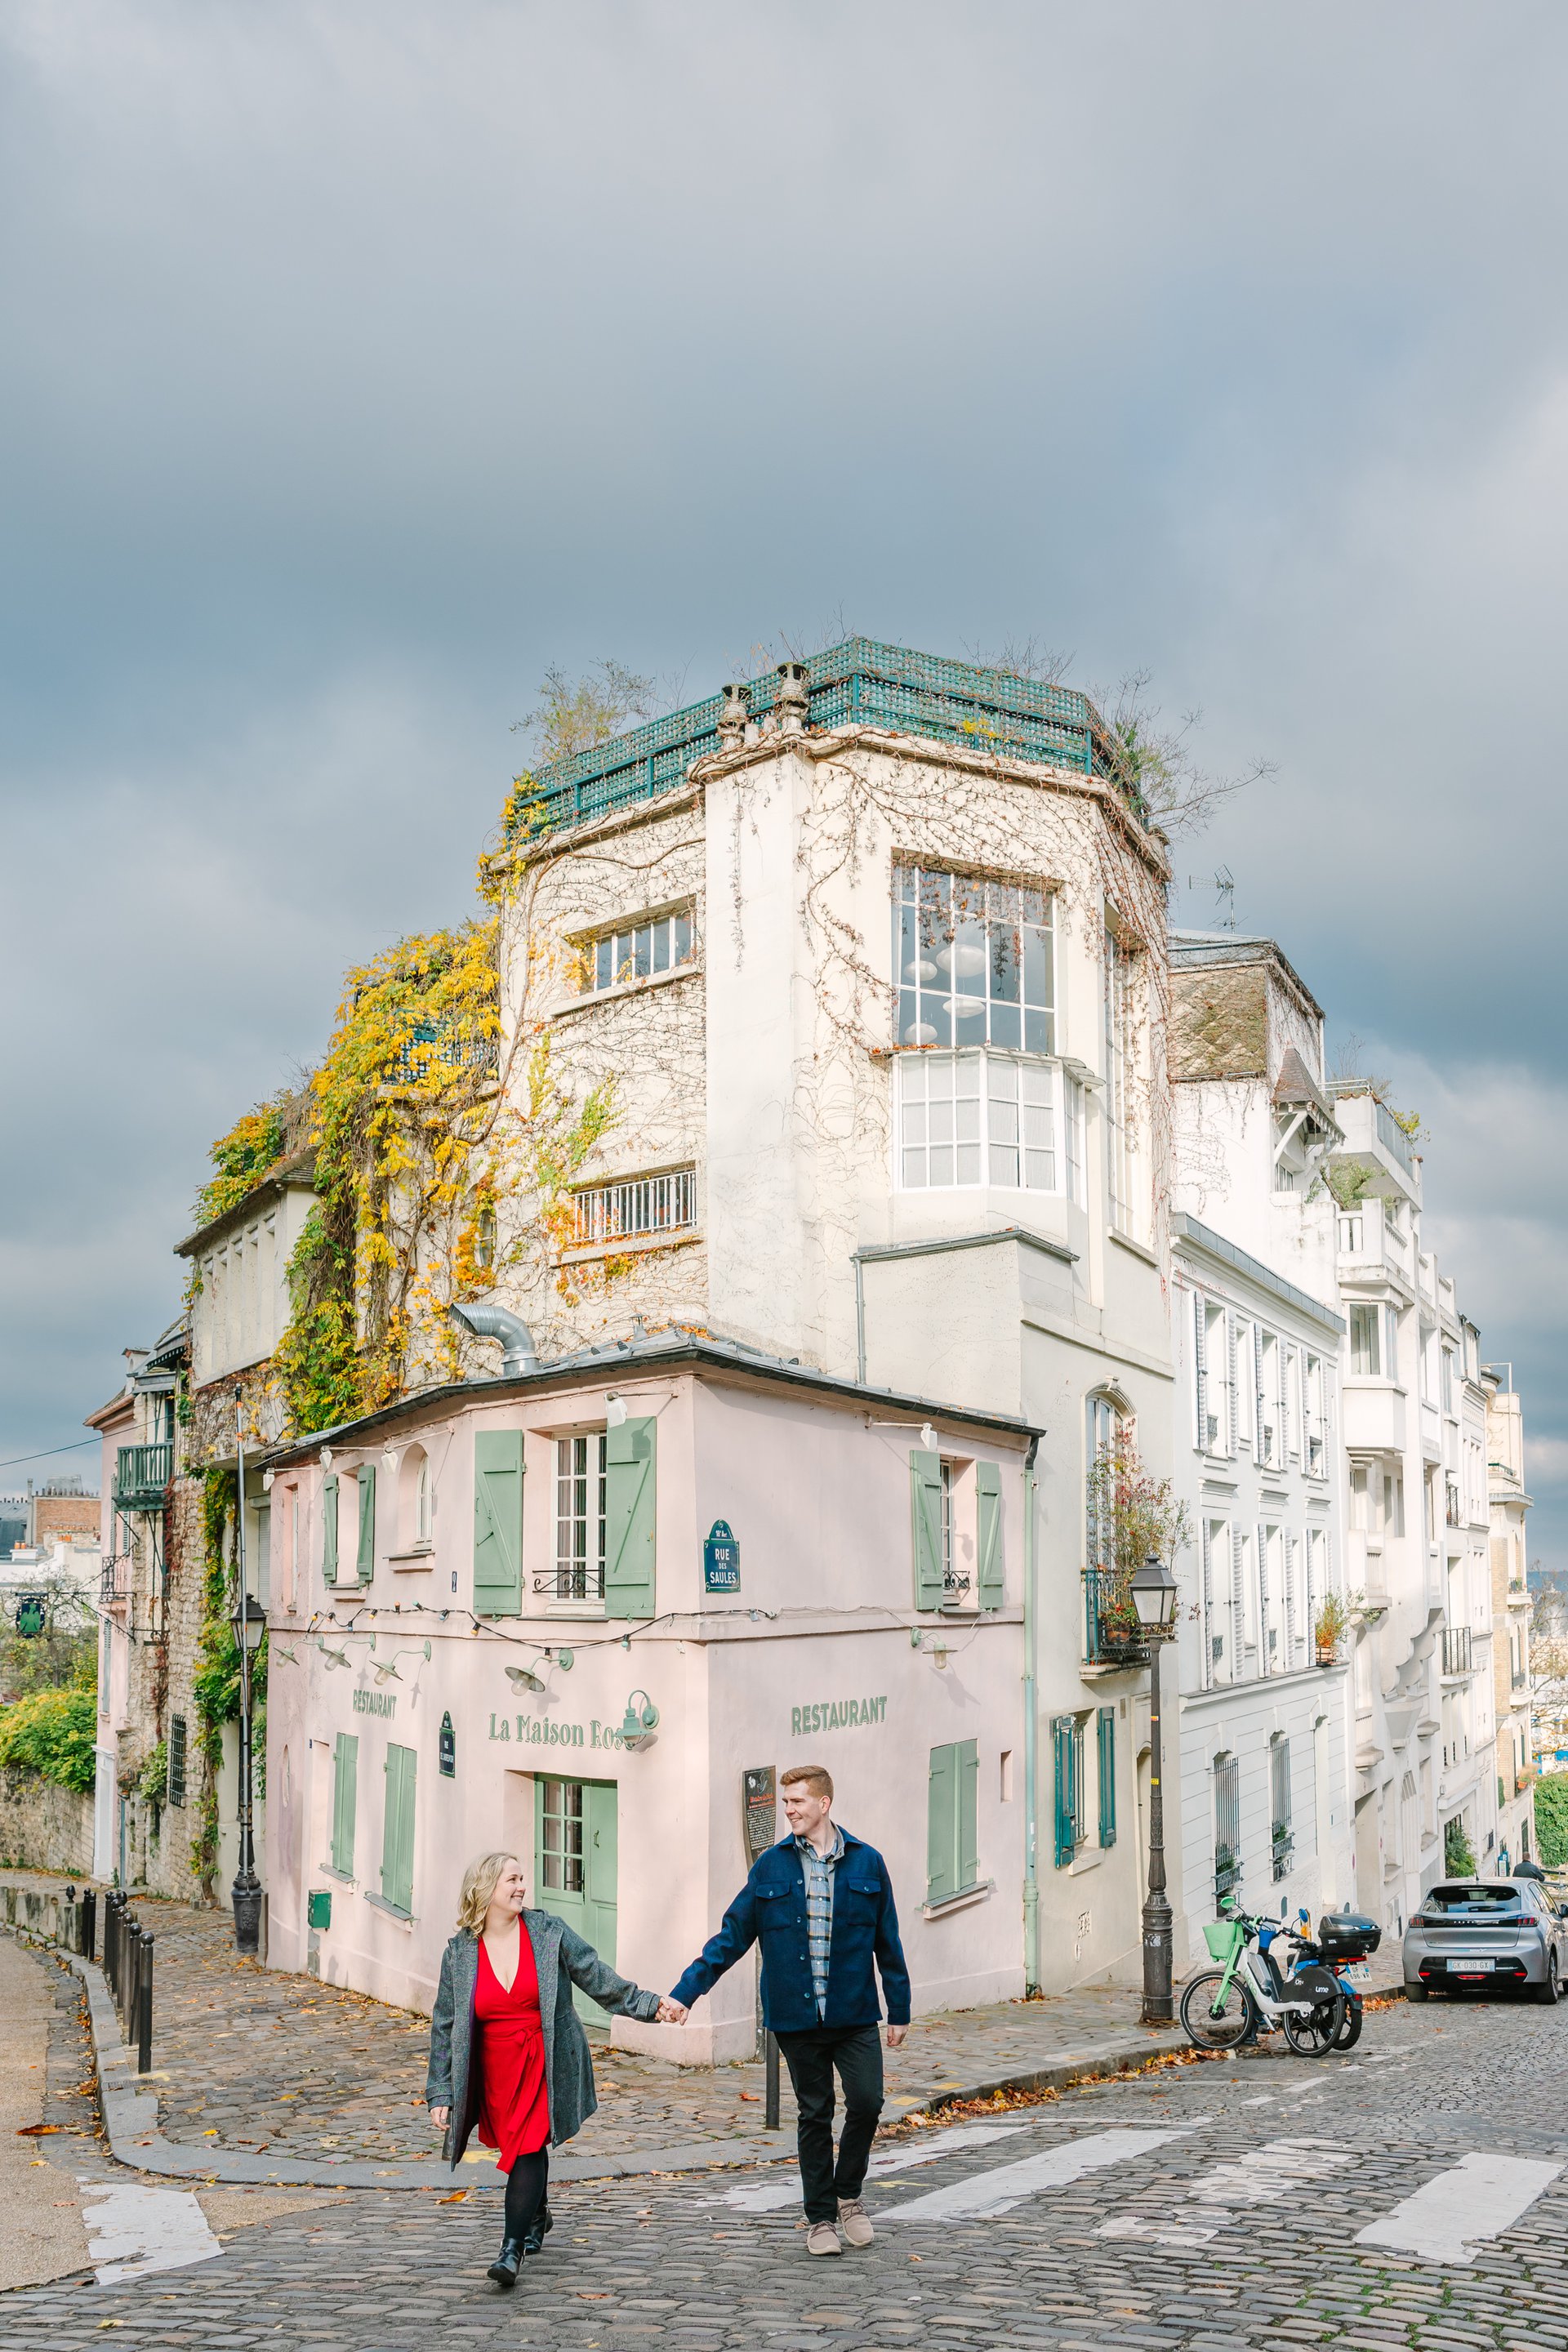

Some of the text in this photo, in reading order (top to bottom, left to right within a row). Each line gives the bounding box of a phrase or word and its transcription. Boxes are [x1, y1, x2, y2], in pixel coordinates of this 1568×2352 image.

[715, 1548, 730, 1561] RUE
[710, 1571, 737, 1584] SAULES
[353, 1689, 397, 1720] RESTAURANT
[791, 1695, 888, 1736] RESTAURANT
[489, 1713, 510, 1741] La
[516, 1715, 584, 1747] Maison
